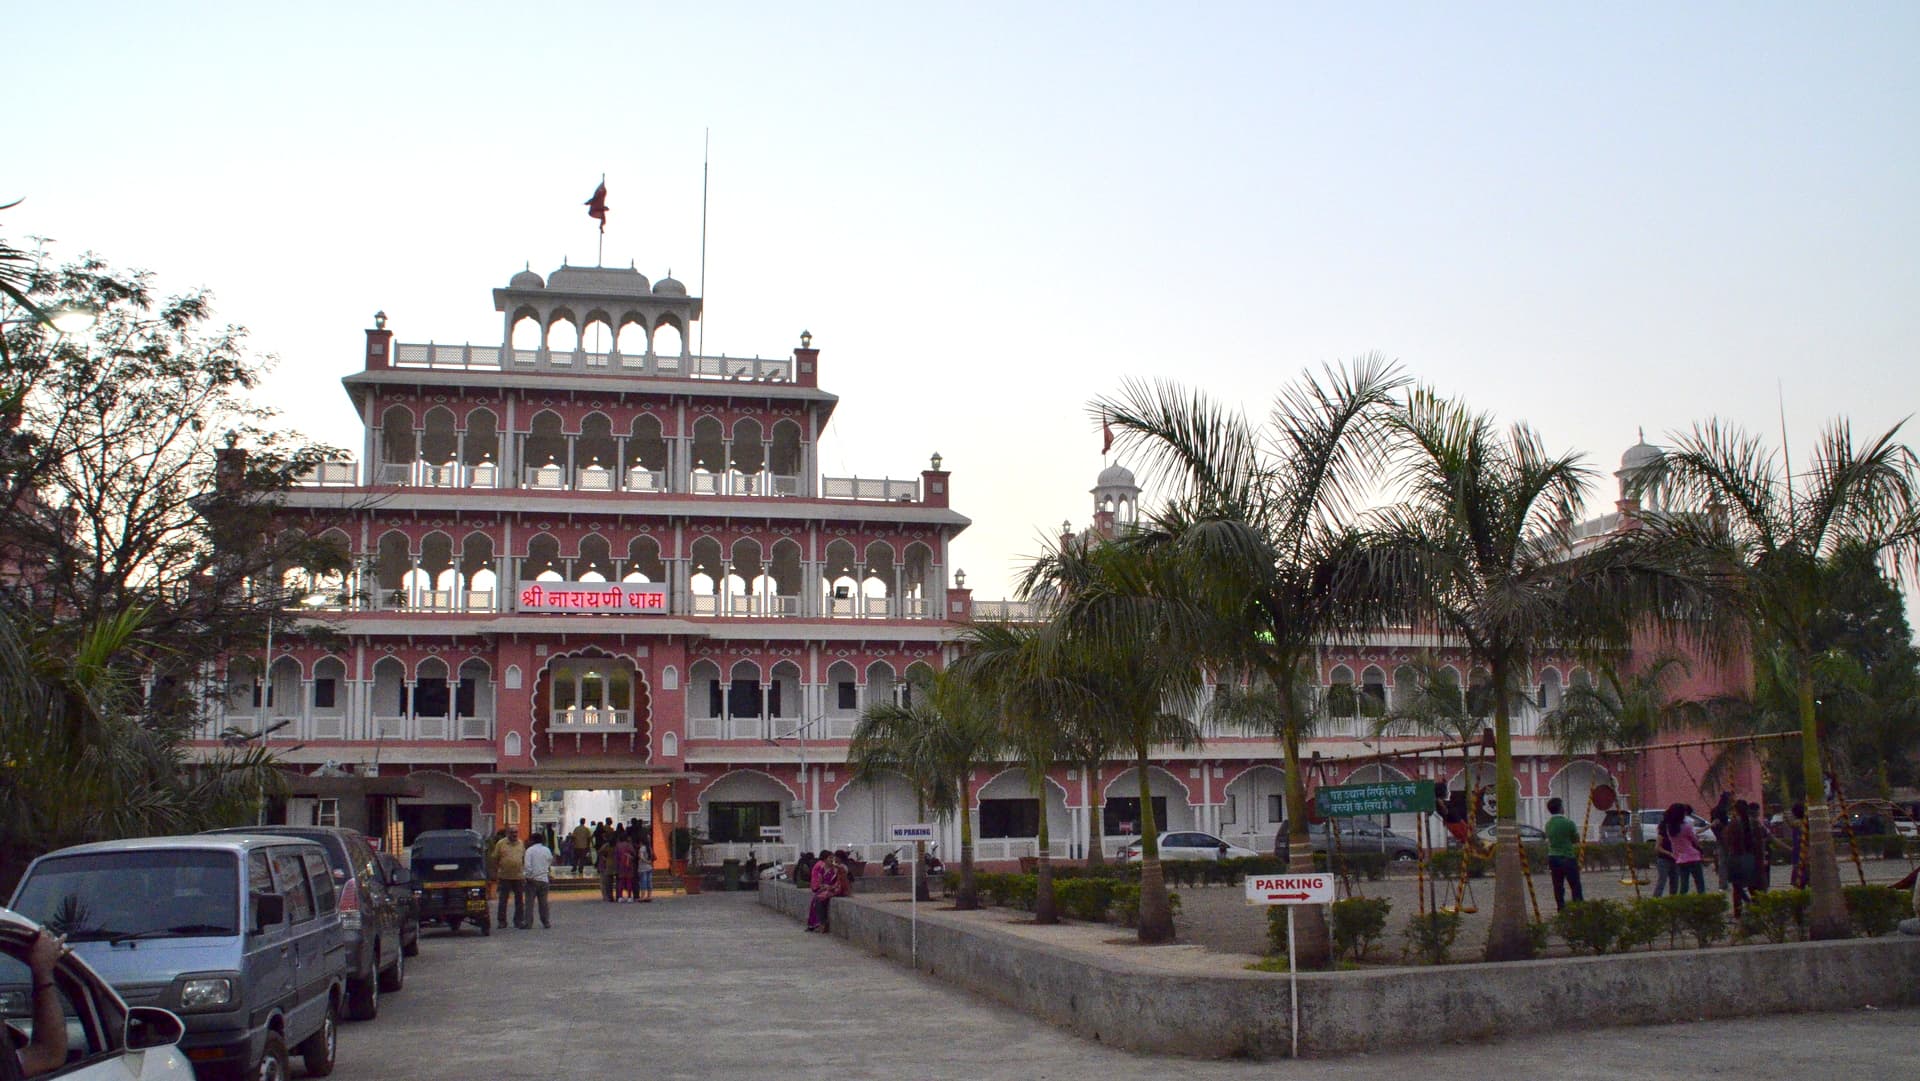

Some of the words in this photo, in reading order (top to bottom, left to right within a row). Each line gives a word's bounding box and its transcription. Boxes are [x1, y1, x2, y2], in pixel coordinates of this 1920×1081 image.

[521, 584, 543, 608] श्री
[548, 586, 623, 609] नारायणी
[628, 591, 664, 609] धाम
[904, 828, 930, 836] PARKING
[1256, 878, 1323, 890] PARKING
